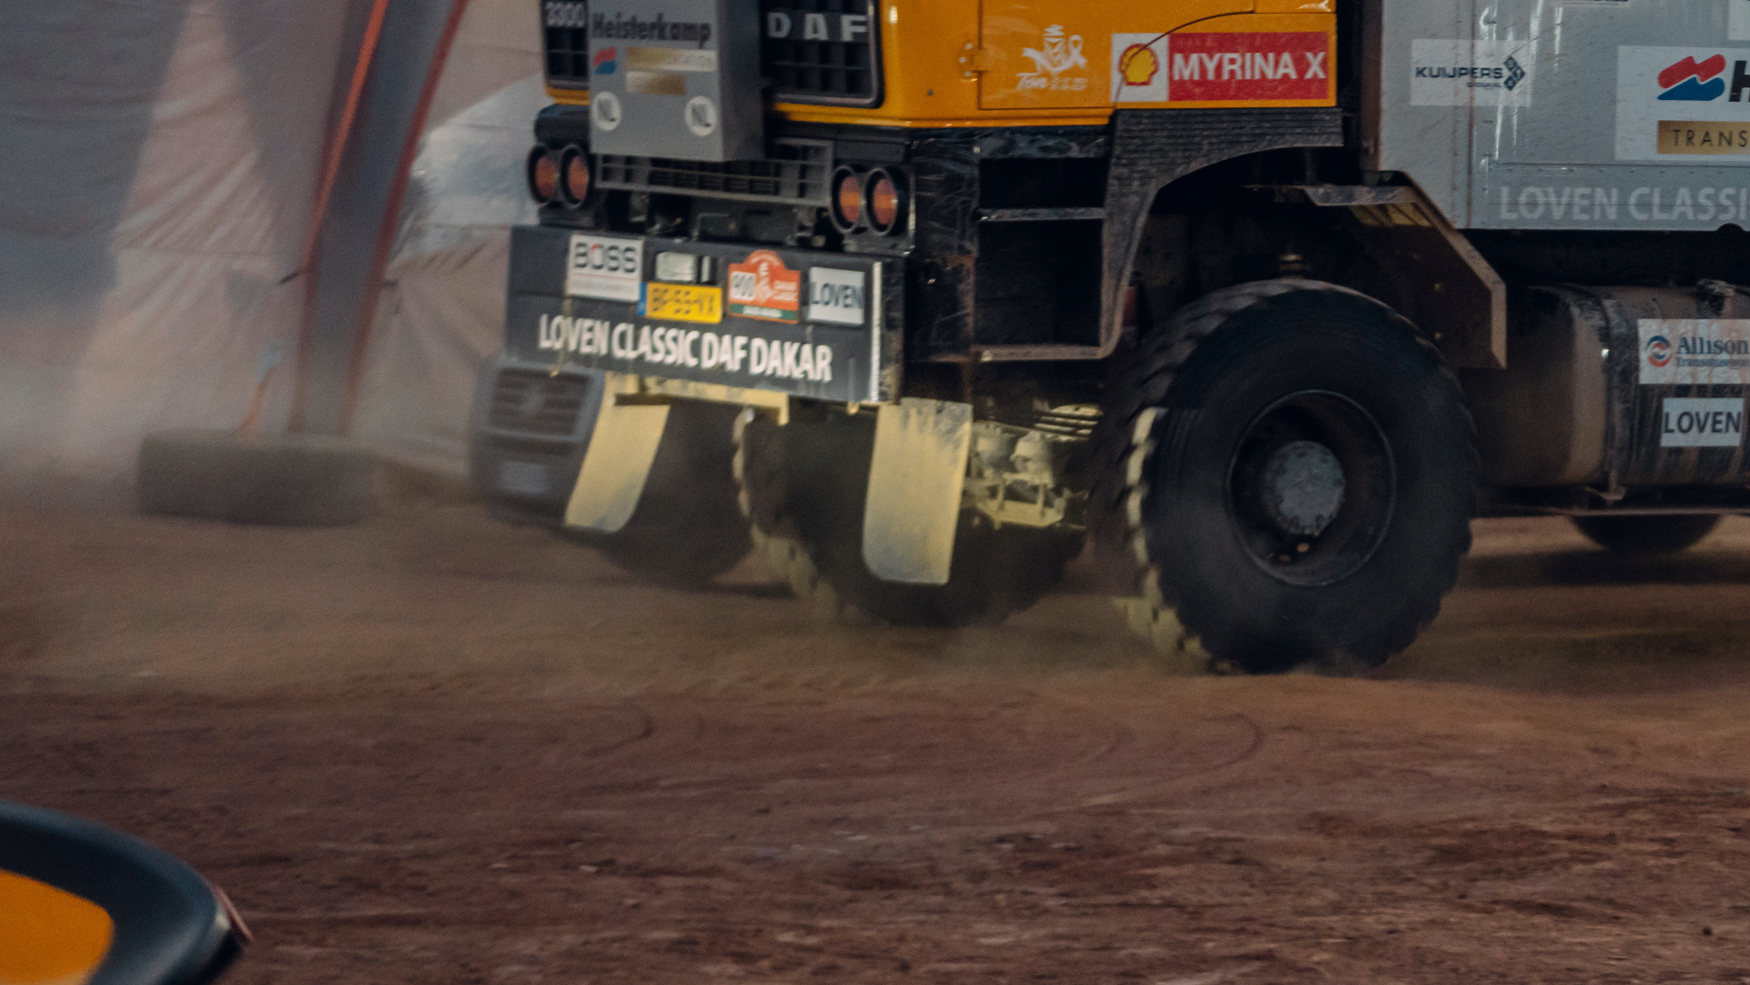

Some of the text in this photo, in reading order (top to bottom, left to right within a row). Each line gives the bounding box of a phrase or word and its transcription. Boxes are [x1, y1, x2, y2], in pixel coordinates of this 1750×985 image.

[593, 11, 711, 49] Heisterkamp
[767, 12, 868, 42] DAF
[1173, 52, 1326, 82] MYRINA X
[1416, 66, 1503, 79] KUIJPERS
[1500, 186, 1617, 220] LOVEN
[575, 242, 637, 273] BOSS
[809, 282, 864, 309] LOVEN
[539, 313, 833, 382] LOVEN CLASSIC DAF DAKAR
[1677, 336, 1749, 354] Allison
[1662, 411, 1742, 434] LOVEN
